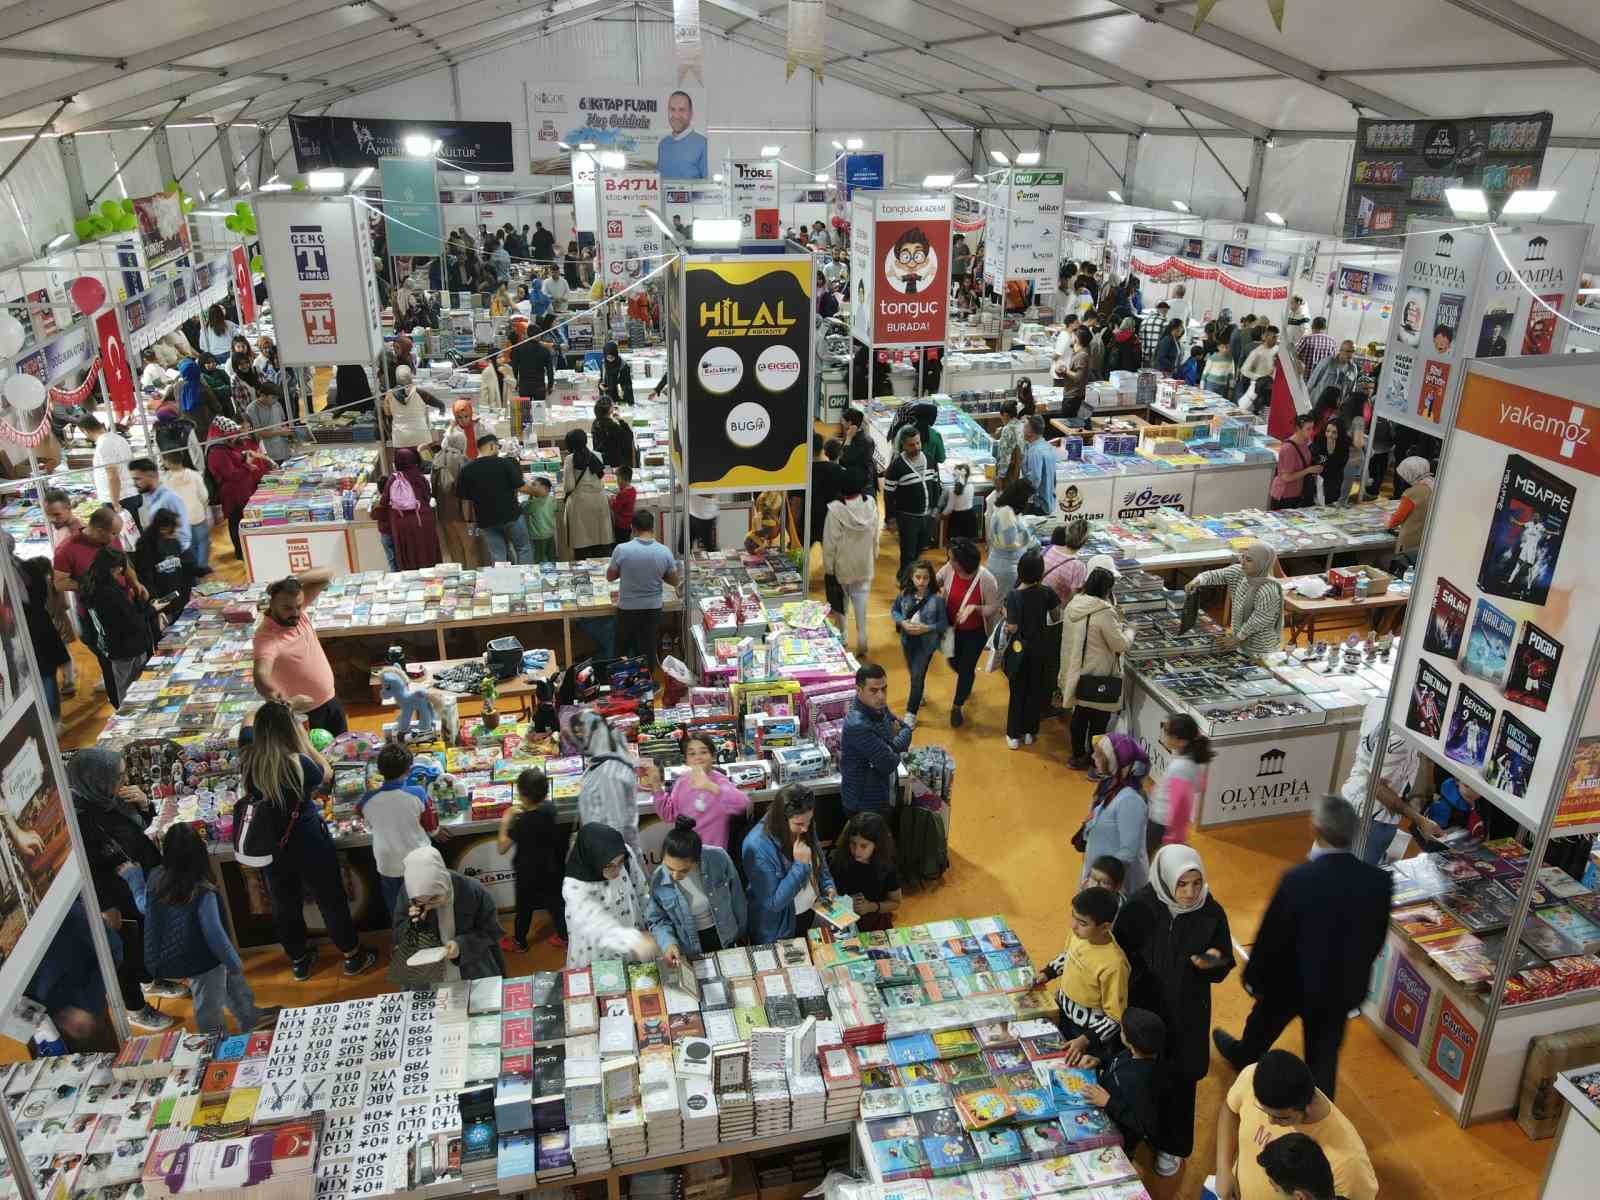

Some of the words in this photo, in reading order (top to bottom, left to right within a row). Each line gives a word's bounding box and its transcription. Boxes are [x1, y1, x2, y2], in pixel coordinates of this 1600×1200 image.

[606, 179, 658, 191] BATU
[1414, 260, 1465, 283] OLYMPİA
[700, 298, 797, 328] HİLAL
[880, 300, 938, 318] tonguç
[887, 322, 930, 333] BURADA!
[1500, 400, 1591, 446] yakamoz
[1135, 487, 1184, 507] Özen
[1514, 474, 1571, 513] MBAPPÉ
[1064, 512, 1105, 522] Noktası
[1442, 588, 1468, 616] SALAH
[1529, 630, 1557, 659] POGBA
[1463, 695, 1492, 721] BENZEMA
[1221, 778, 1311, 805] OLYMPİA
[411, 1012, 434, 1021] 123
[370, 1049, 396, 1061] ABC
[407, 1047, 432, 1057] 123
[403, 1083, 428, 1095] 123
[367, 1093, 394, 1106] ABC
[363, 1121, 390, 1135] SUS
[356, 1165, 384, 1179] SUS
